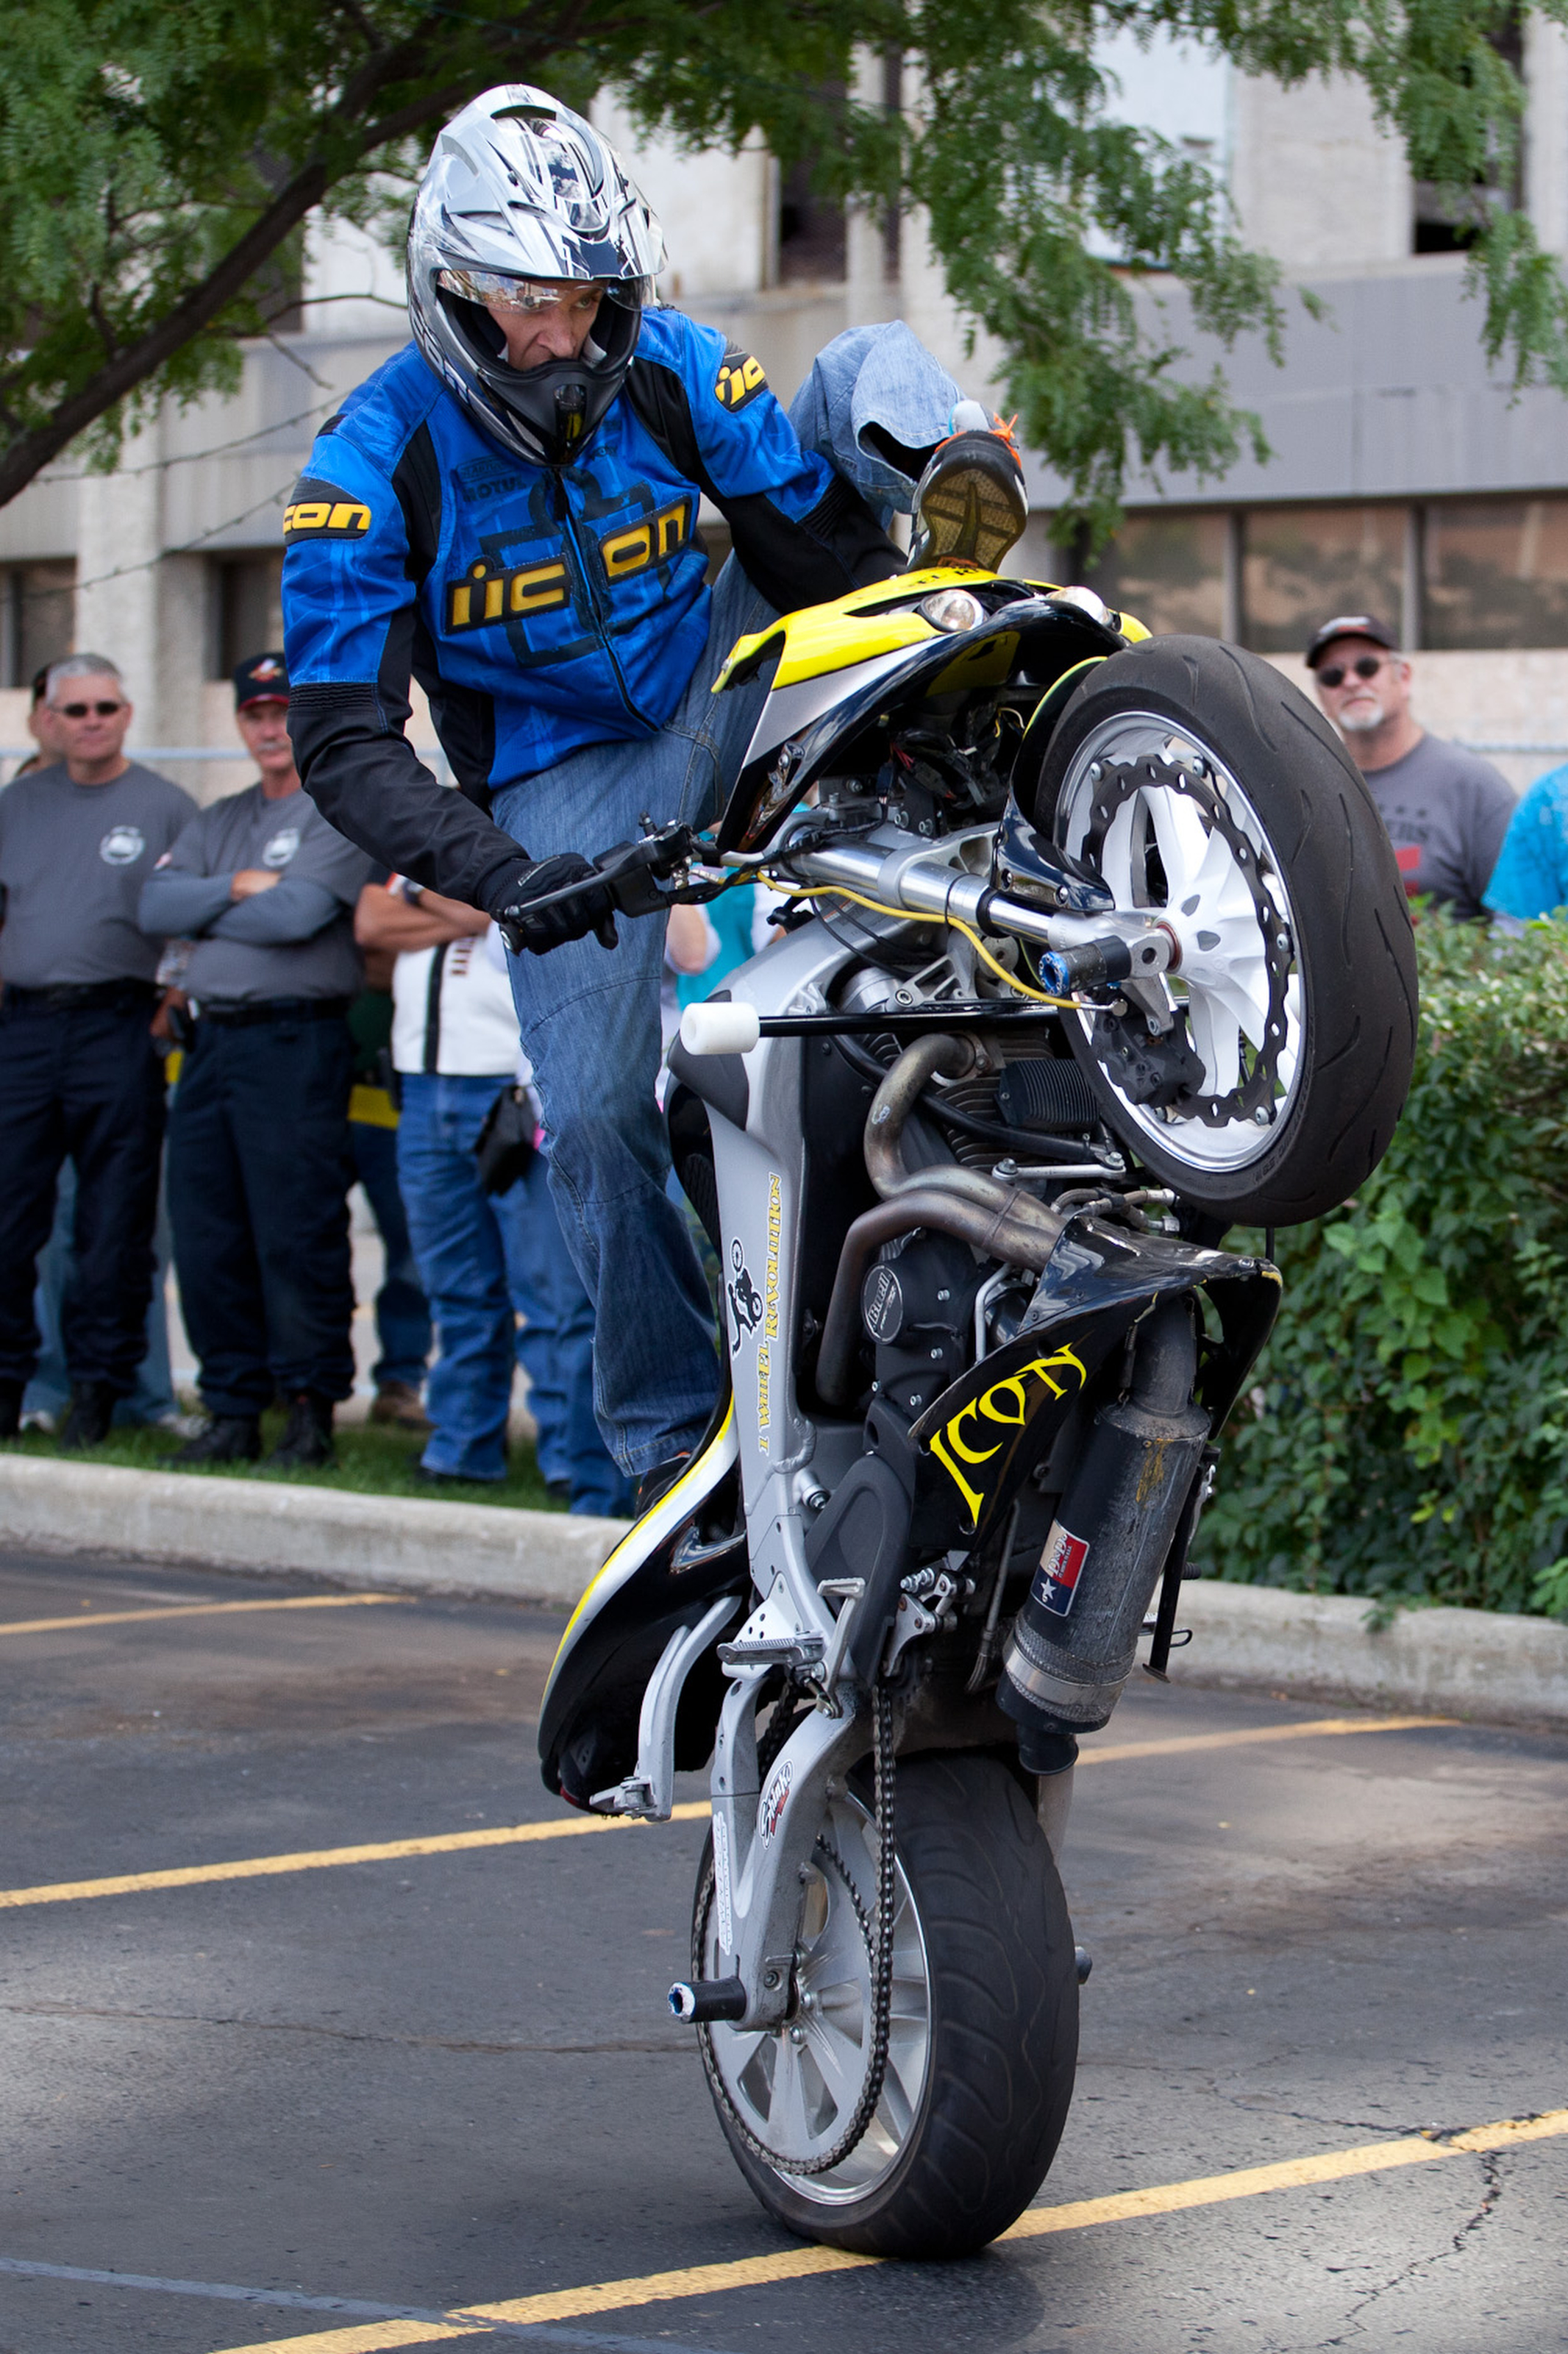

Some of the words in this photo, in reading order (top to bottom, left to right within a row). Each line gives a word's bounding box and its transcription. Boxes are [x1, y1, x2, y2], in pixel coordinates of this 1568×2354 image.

[766, 1174, 780, 1339] REVOLUTION
[868, 1272, 891, 1326] Buell
[930, 1343, 1086, 1526] ICON
[1047, 1537, 1068, 1575] D&D
